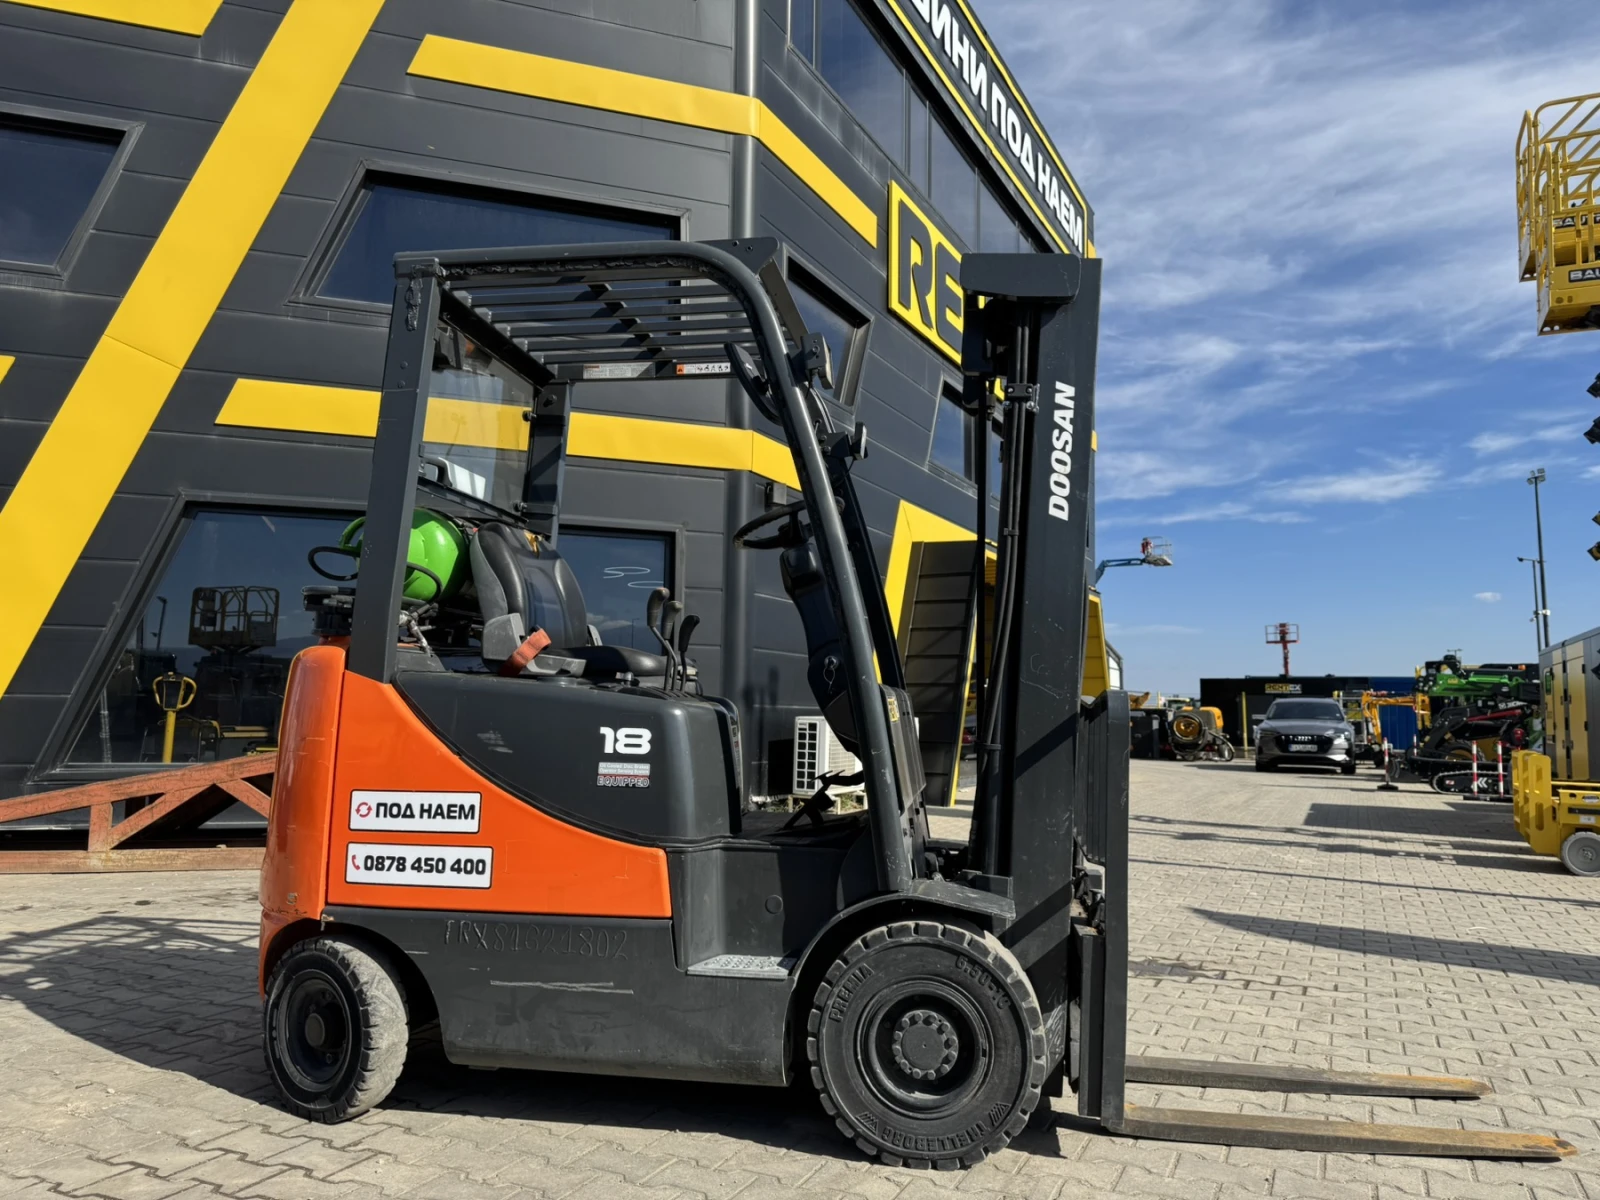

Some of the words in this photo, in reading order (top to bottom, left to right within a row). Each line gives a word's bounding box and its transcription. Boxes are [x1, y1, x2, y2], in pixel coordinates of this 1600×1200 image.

[991, 82, 1035, 182] ПОД
[1038, 152, 1083, 253] НАЕМ
[1048, 381, 1075, 521] DOOSAN
[599, 726, 652, 755] 18
[597, 775, 650, 788] EQUIPPED
[375, 802, 415, 819] ПОД
[420, 803, 476, 820] НАЕМ
[363, 855, 407, 872] 0878
[410, 857, 446, 874] 450
[449, 858, 487, 876] 400
[829, 963, 875, 1023] PREMIA
[882, 1119, 991, 1152] TRELLEBORG
